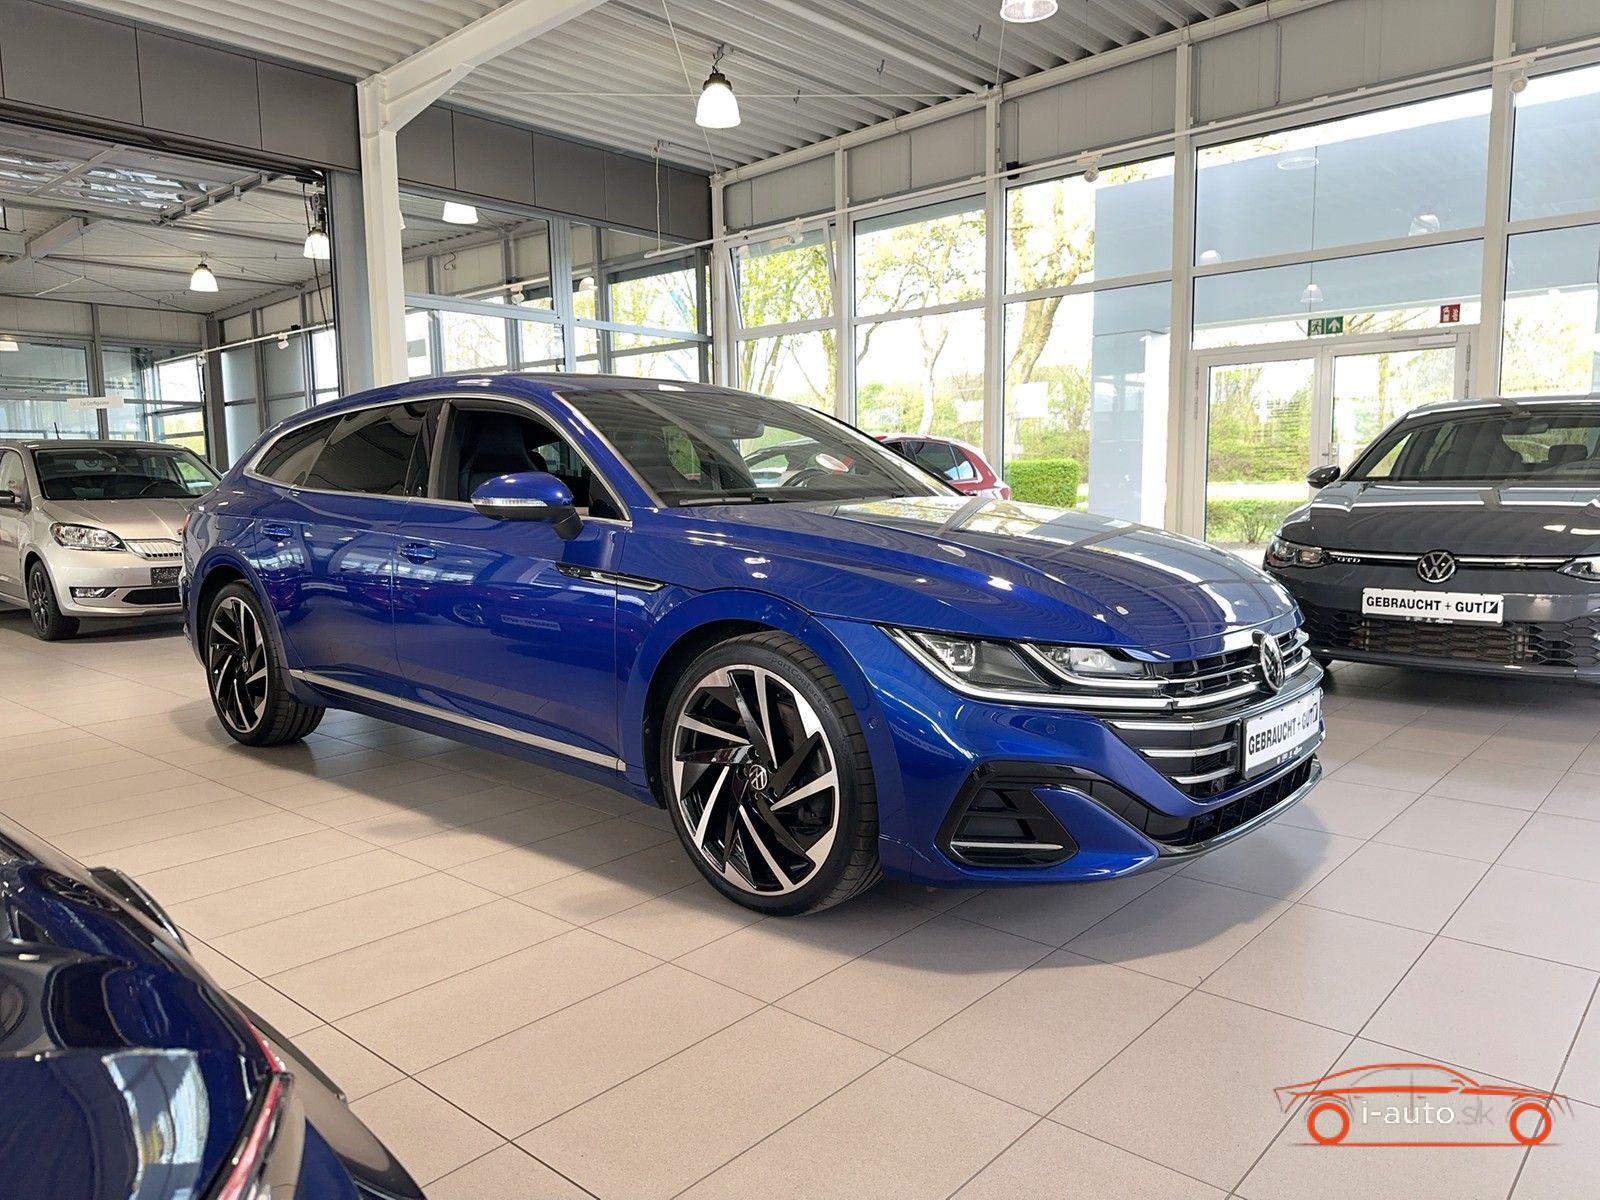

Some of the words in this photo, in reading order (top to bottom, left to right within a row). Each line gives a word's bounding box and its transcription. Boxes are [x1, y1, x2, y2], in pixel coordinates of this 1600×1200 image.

[1366, 596, 1441, 611] GEBRAUCHT
[1444, 602, 1452, 611] +
[1455, 602, 1483, 613] GUT
[1248, 717, 1297, 755] GEBRAUCHT
